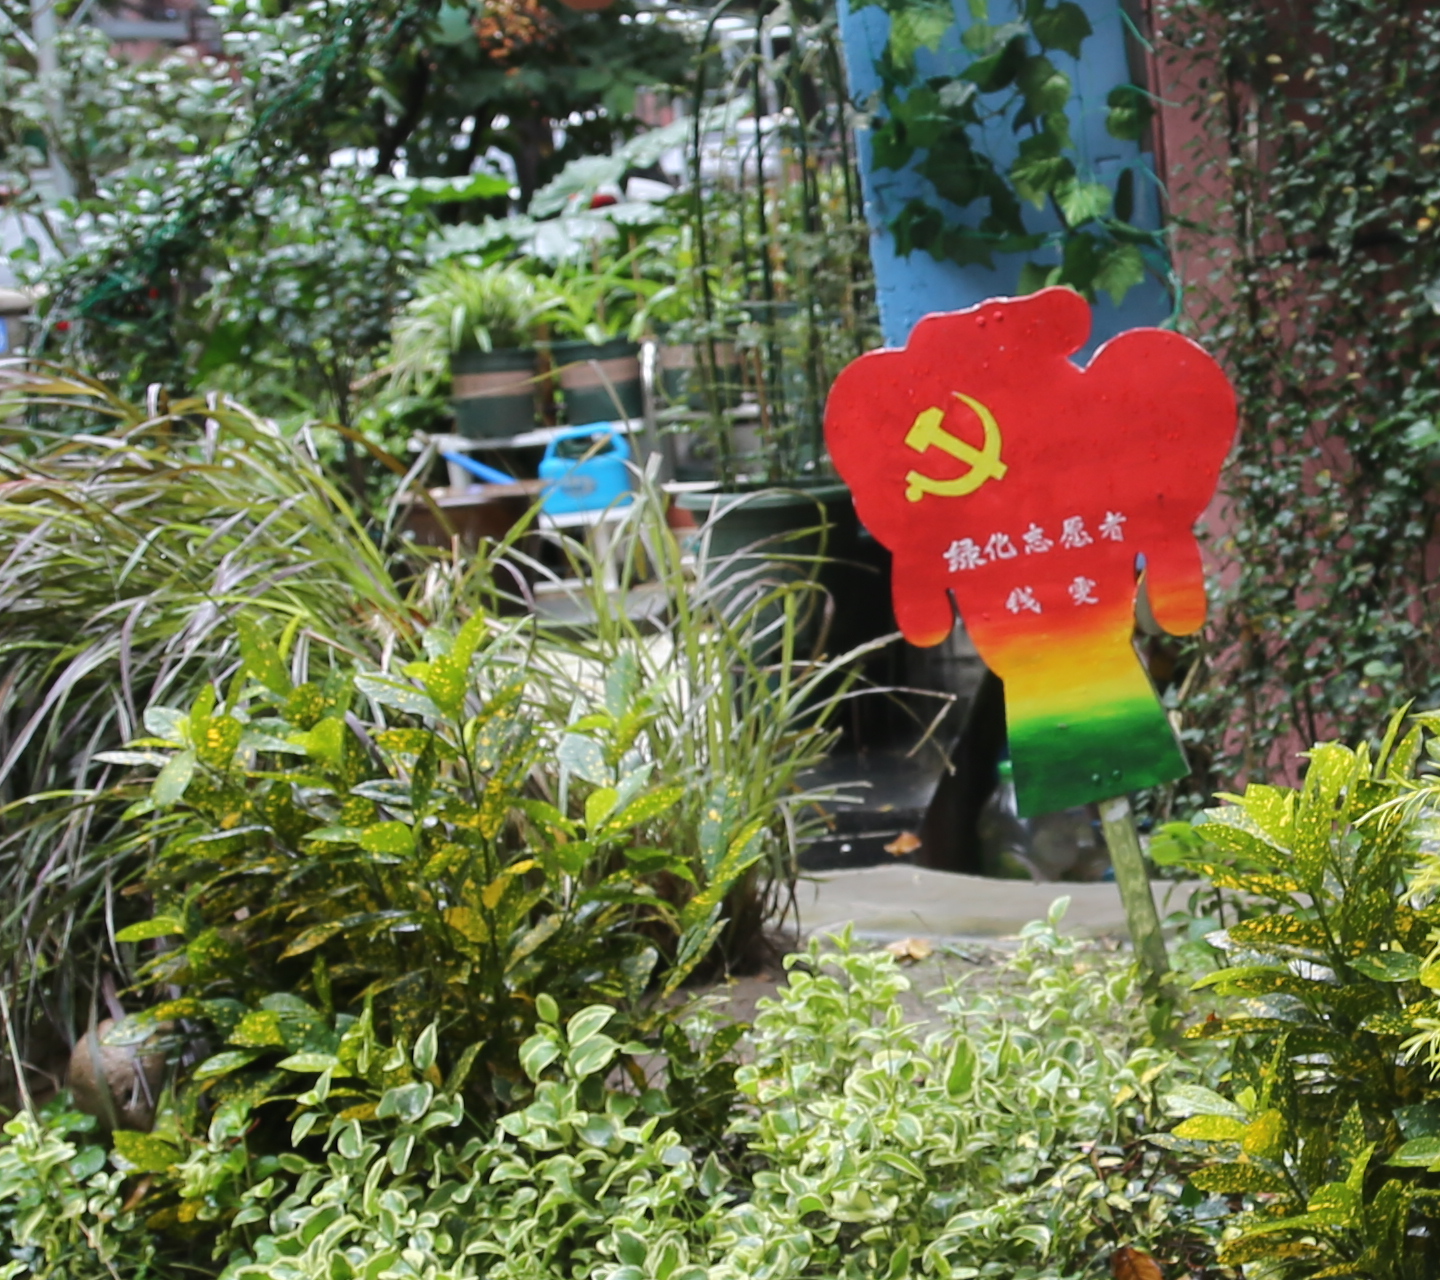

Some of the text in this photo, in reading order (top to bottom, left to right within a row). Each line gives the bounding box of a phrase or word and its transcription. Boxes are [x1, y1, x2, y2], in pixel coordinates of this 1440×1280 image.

[942, 510, 1127, 573] 绿化志愿者
